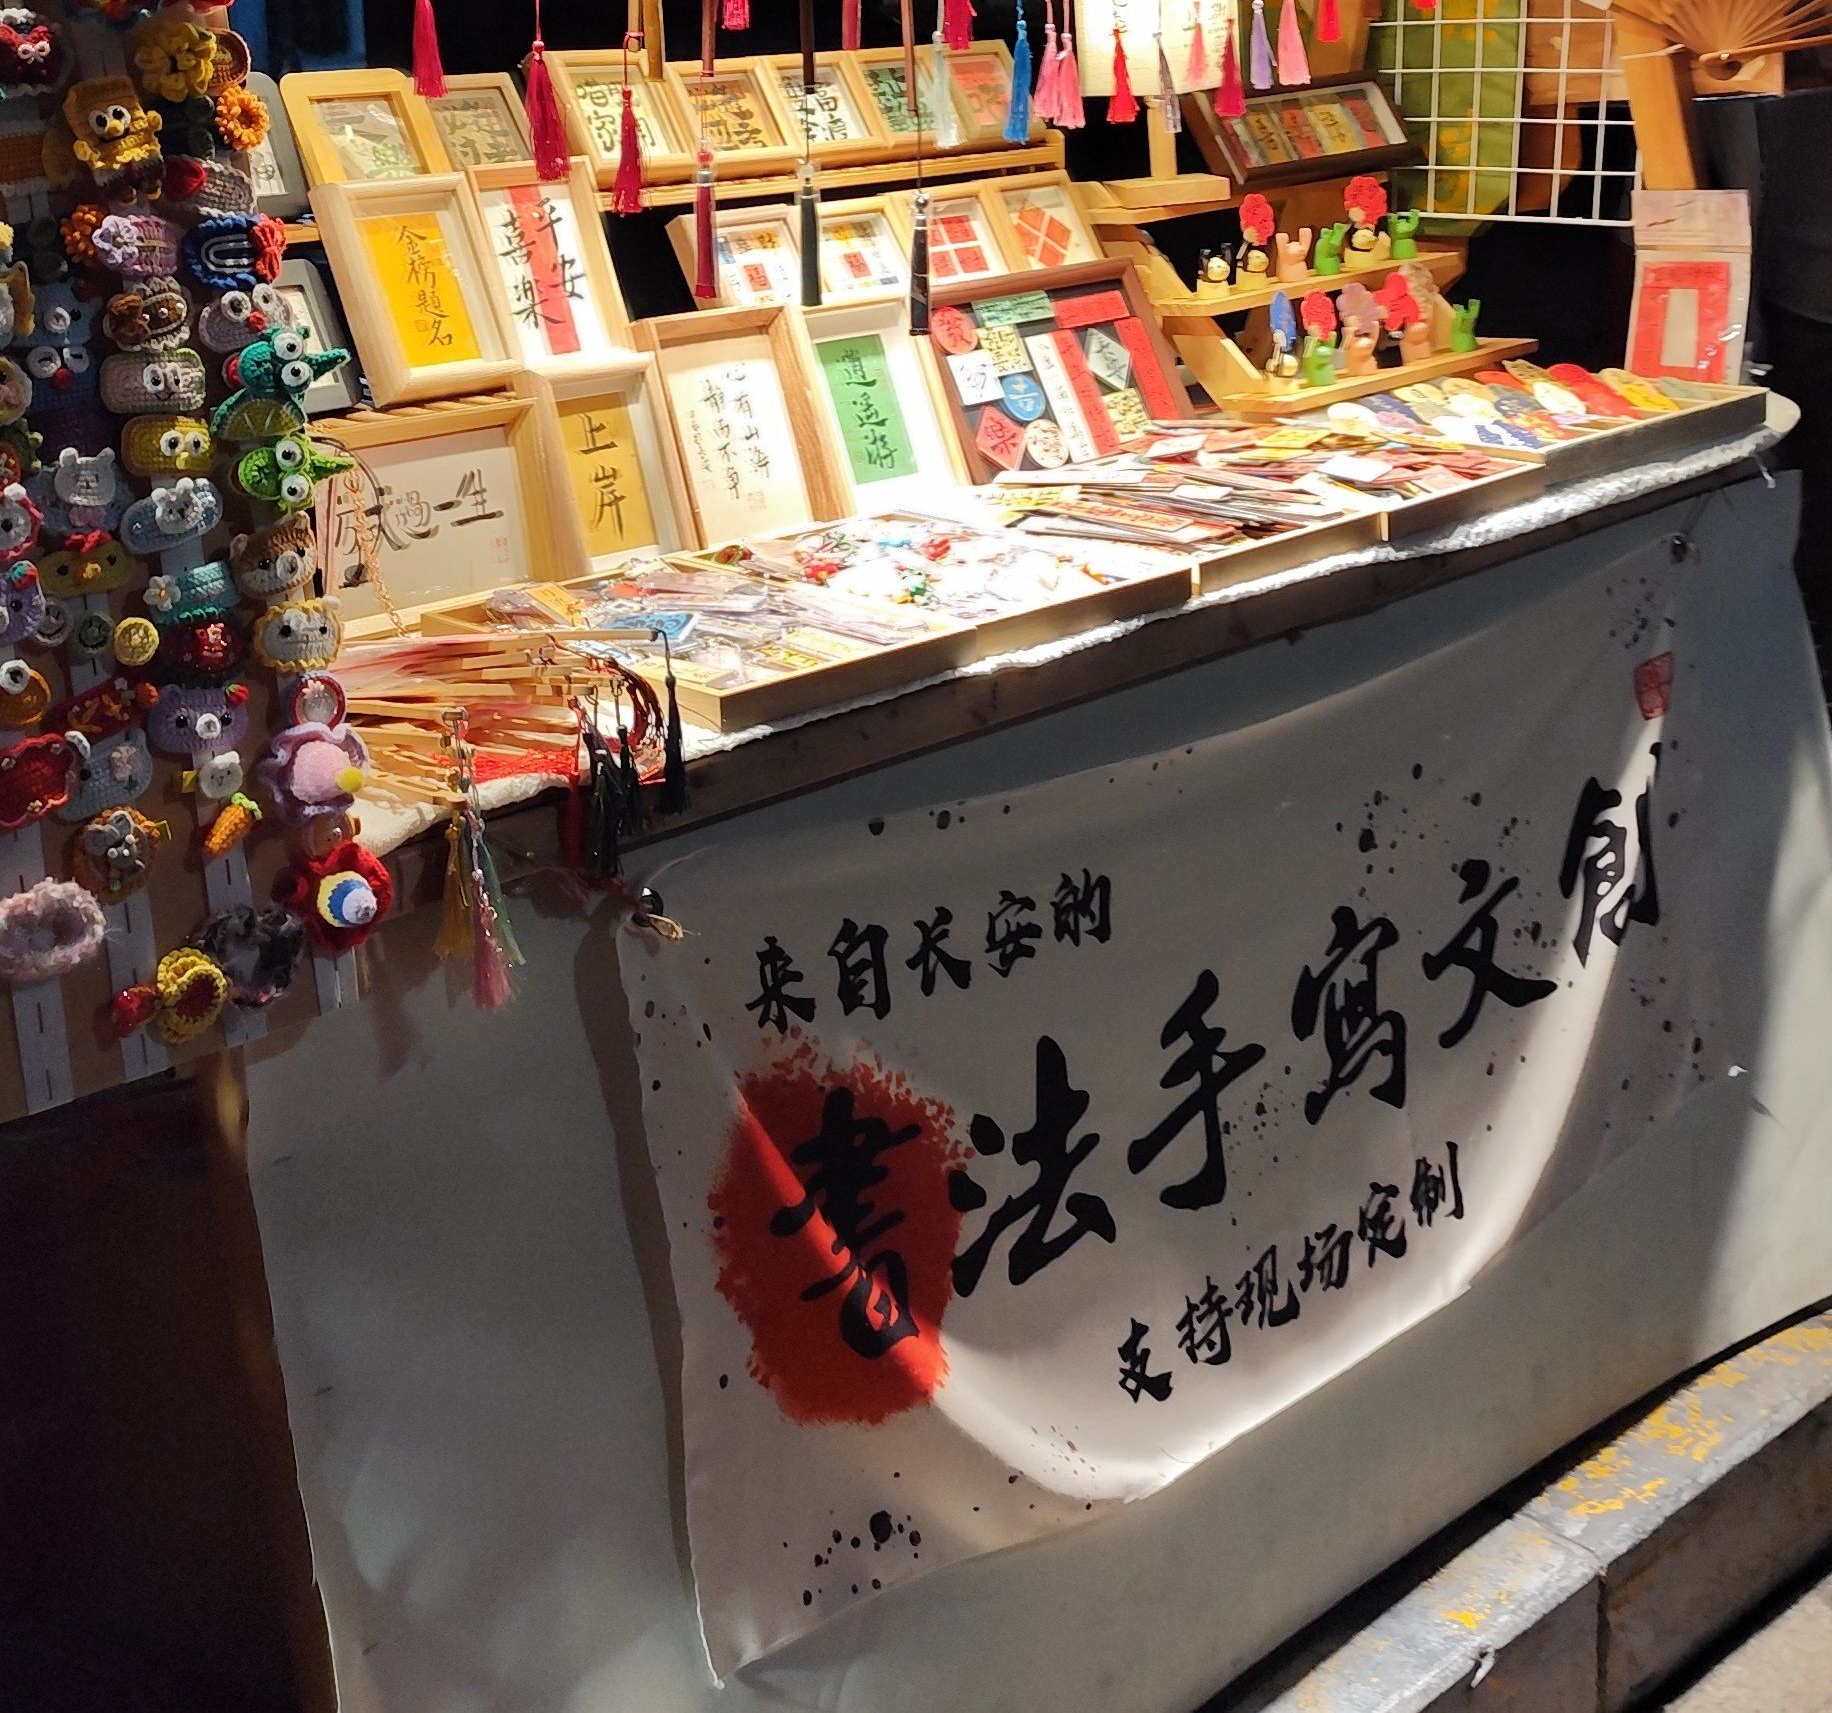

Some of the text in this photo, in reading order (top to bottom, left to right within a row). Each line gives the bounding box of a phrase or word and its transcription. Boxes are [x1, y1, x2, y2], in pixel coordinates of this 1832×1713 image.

[576, 413, 626, 541] 上岸
[1117, 1140, 1465, 1404] 支持现场定制
